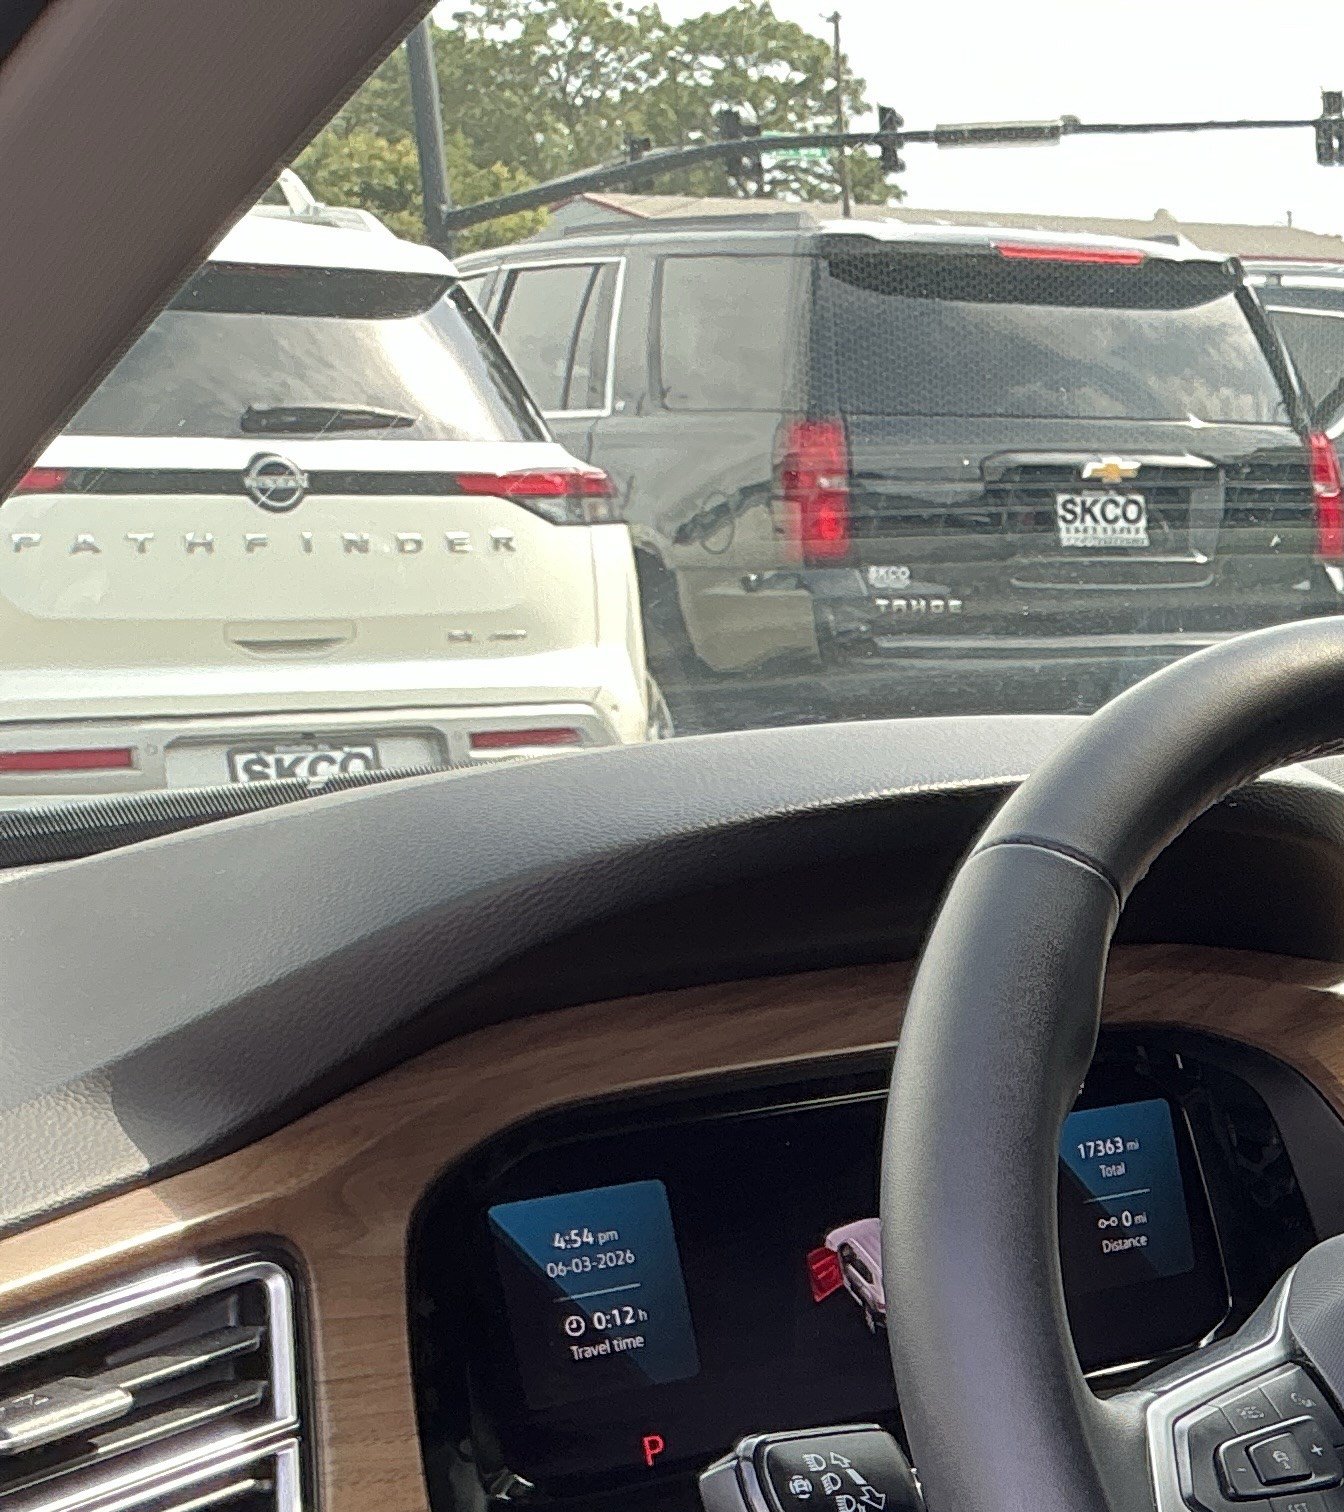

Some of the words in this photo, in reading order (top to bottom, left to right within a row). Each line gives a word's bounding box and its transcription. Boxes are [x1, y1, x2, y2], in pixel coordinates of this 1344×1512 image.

[1059, 497, 1143, 525] SKCO
[11, 528, 517, 554] PATHFINDER
[875, 598, 962, 614] TAHOE
[1077, 1136, 1123, 1159] 17363
[1126, 1138, 1140, 1152] mi
[1099, 1161, 1126, 1178] Total
[1121, 1209, 1132, 1227] 0
[1133, 1211, 1148, 1225] mi
[553, 1227, 595, 1250] 4:54
[597, 1230, 619, 1246] pm
[1101, 1235, 1148, 1253] Distance
[546, 1249, 636, 1278] 06-03-2026
[592, 1305, 636, 1330] 0:12
[569, 1339, 611, 1360] Travel
[612, 1335, 645, 1352] time
[643, 1435, 664, 1466] P
